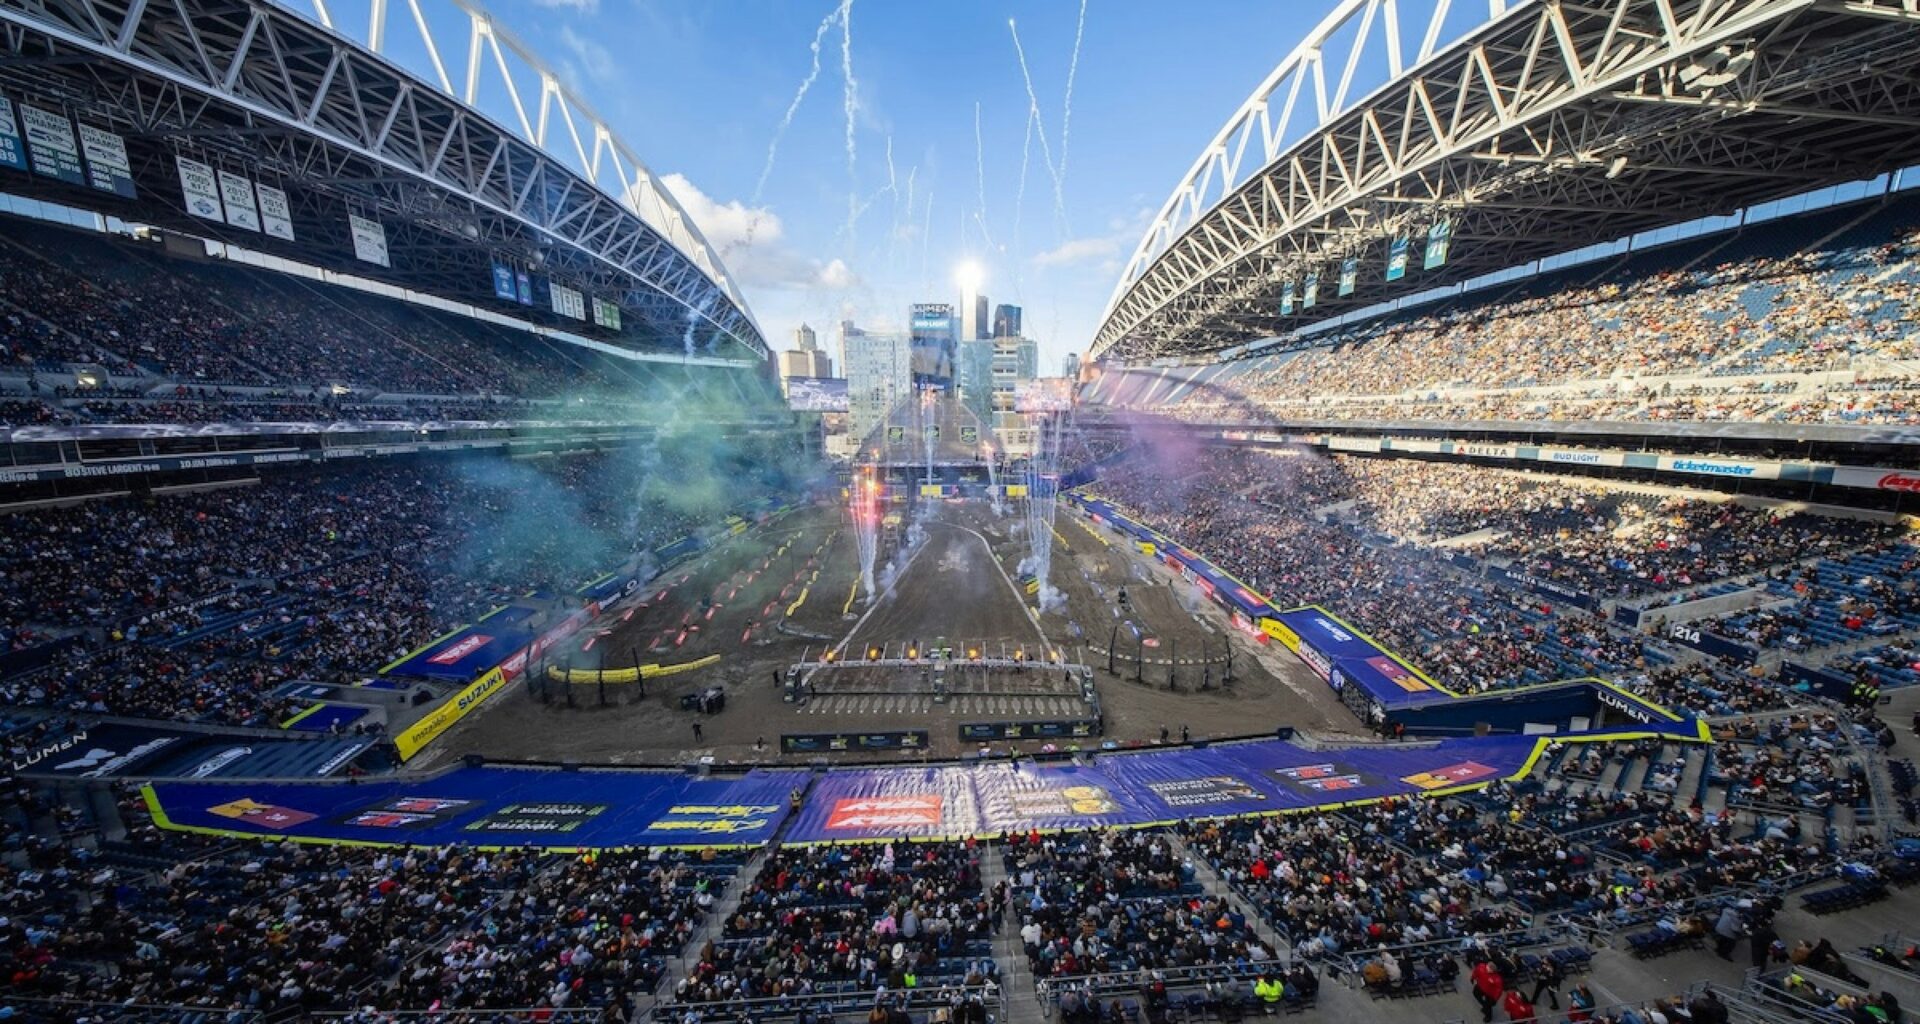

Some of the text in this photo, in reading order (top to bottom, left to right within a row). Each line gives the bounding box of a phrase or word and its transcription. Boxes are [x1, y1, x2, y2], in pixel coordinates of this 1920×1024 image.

[185, 172, 210, 186] 2005
[190, 181, 209, 193] NFC
[226, 185, 249, 198] 2013
[913, 304, 950, 313] LUMEN
[1469, 446, 1508, 457] DELTA
[1553, 452, 1599, 463] BUD LIGHT
[82, 465, 108, 477] STEVE
[108, 463, 142, 475] LARGENT
[180, 460, 191, 469] 10
[1673, 460, 1755, 475] ticketmaster
[1674, 625, 1700, 644] 214
[458, 671, 502, 710] SUZUKI
[1597, 690, 1650, 724] LUMEN
[13, 731, 88, 771] LUMEN
